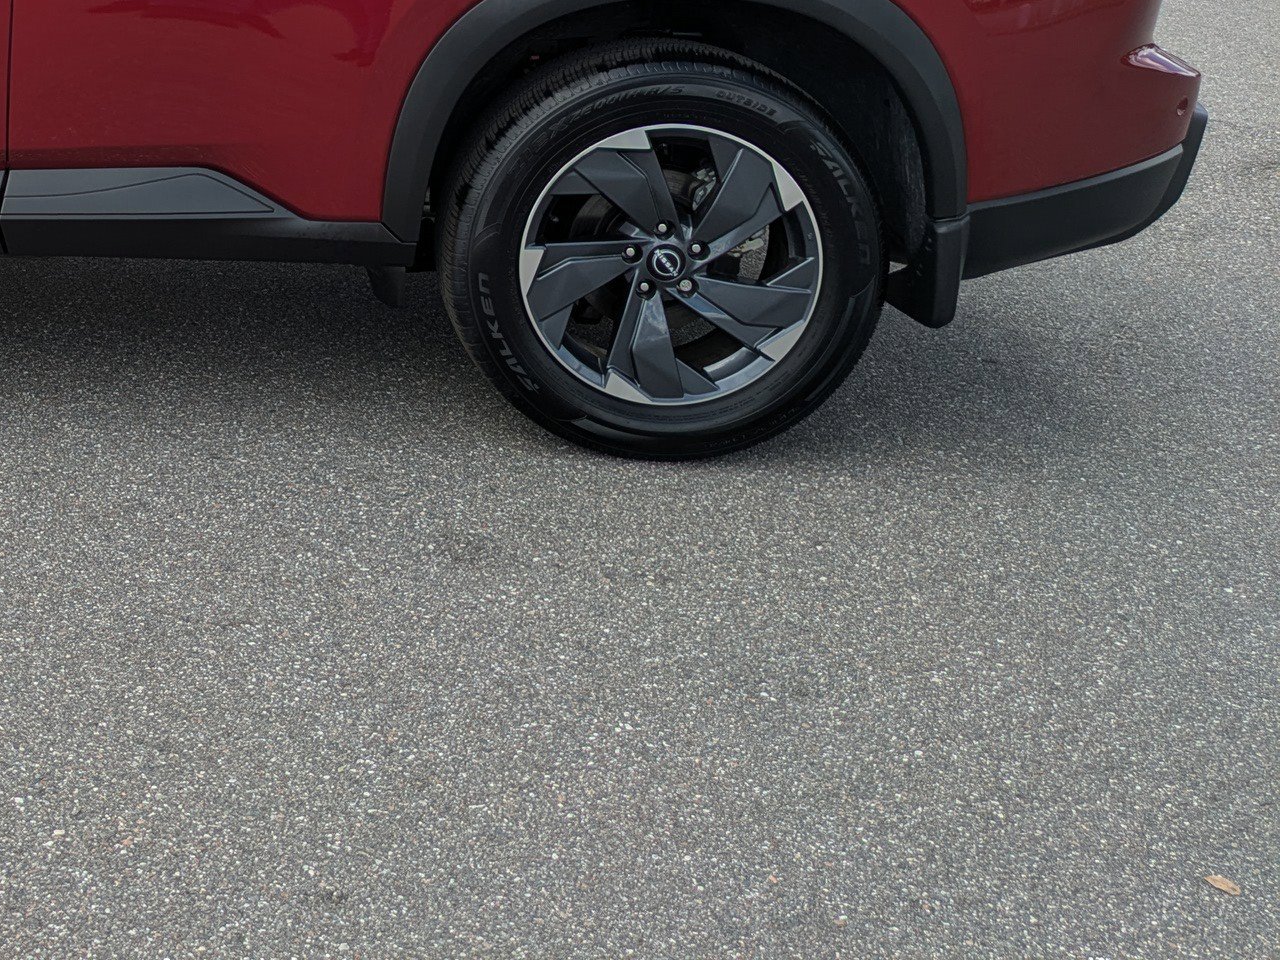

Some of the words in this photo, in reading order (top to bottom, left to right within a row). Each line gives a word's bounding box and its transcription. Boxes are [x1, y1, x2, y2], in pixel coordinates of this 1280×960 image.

[716, 90, 778, 117] OUTSIDE
[654, 249, 678, 277] NISSAN
[478, 272, 540, 394] FALKEN
